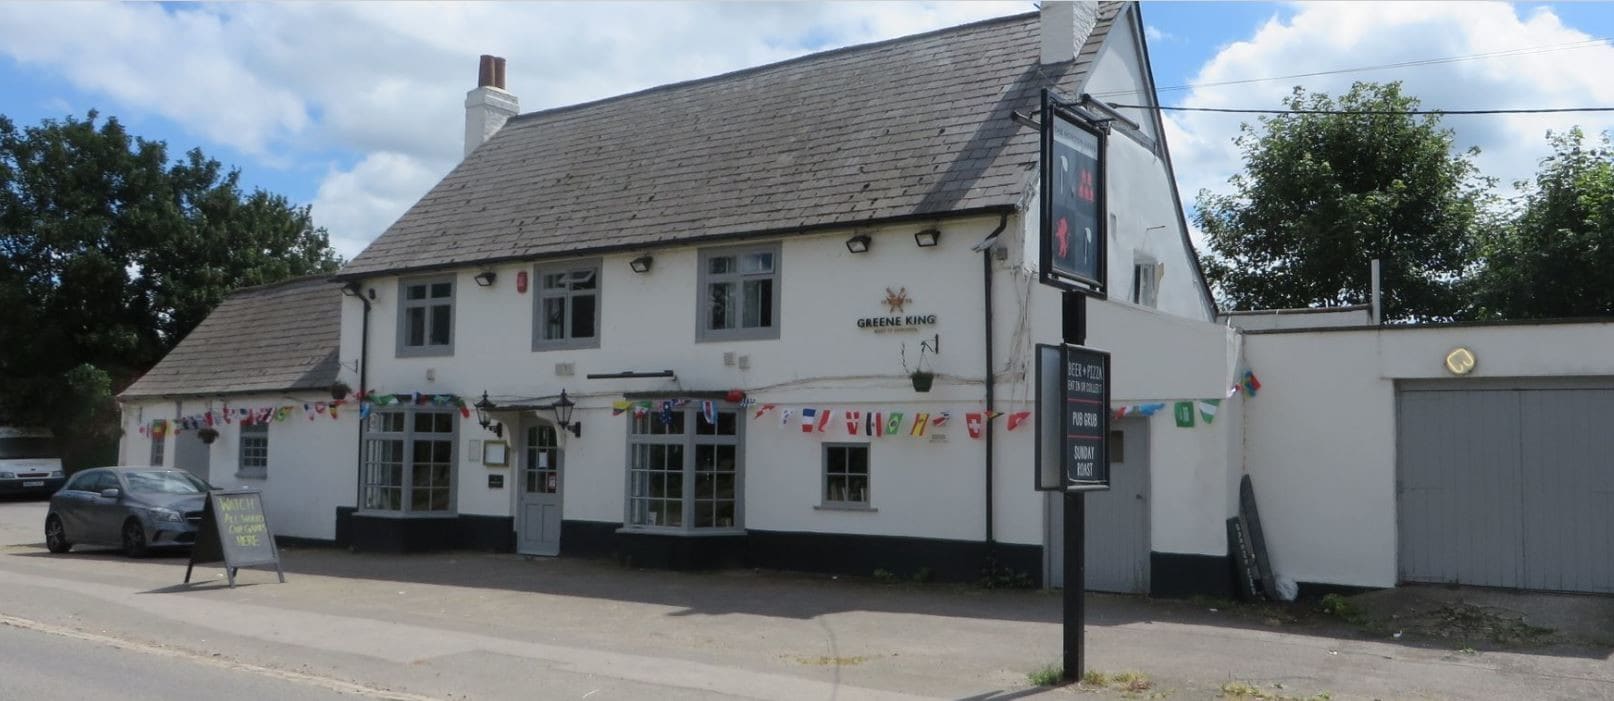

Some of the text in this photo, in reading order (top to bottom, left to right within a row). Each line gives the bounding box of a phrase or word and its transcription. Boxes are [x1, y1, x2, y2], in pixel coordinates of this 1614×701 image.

[857, 315, 937, 328] GREENE KING
[1068, 362, 1082, 377] BEER
[1087, 364, 1103, 380] PIZZA
[1072, 411, 1097, 427] PUB GRUB
[1074, 445, 1095, 460] SUNDAY
[1077, 462, 1094, 477] ROAST
[219, 497, 255, 511] WATCH
